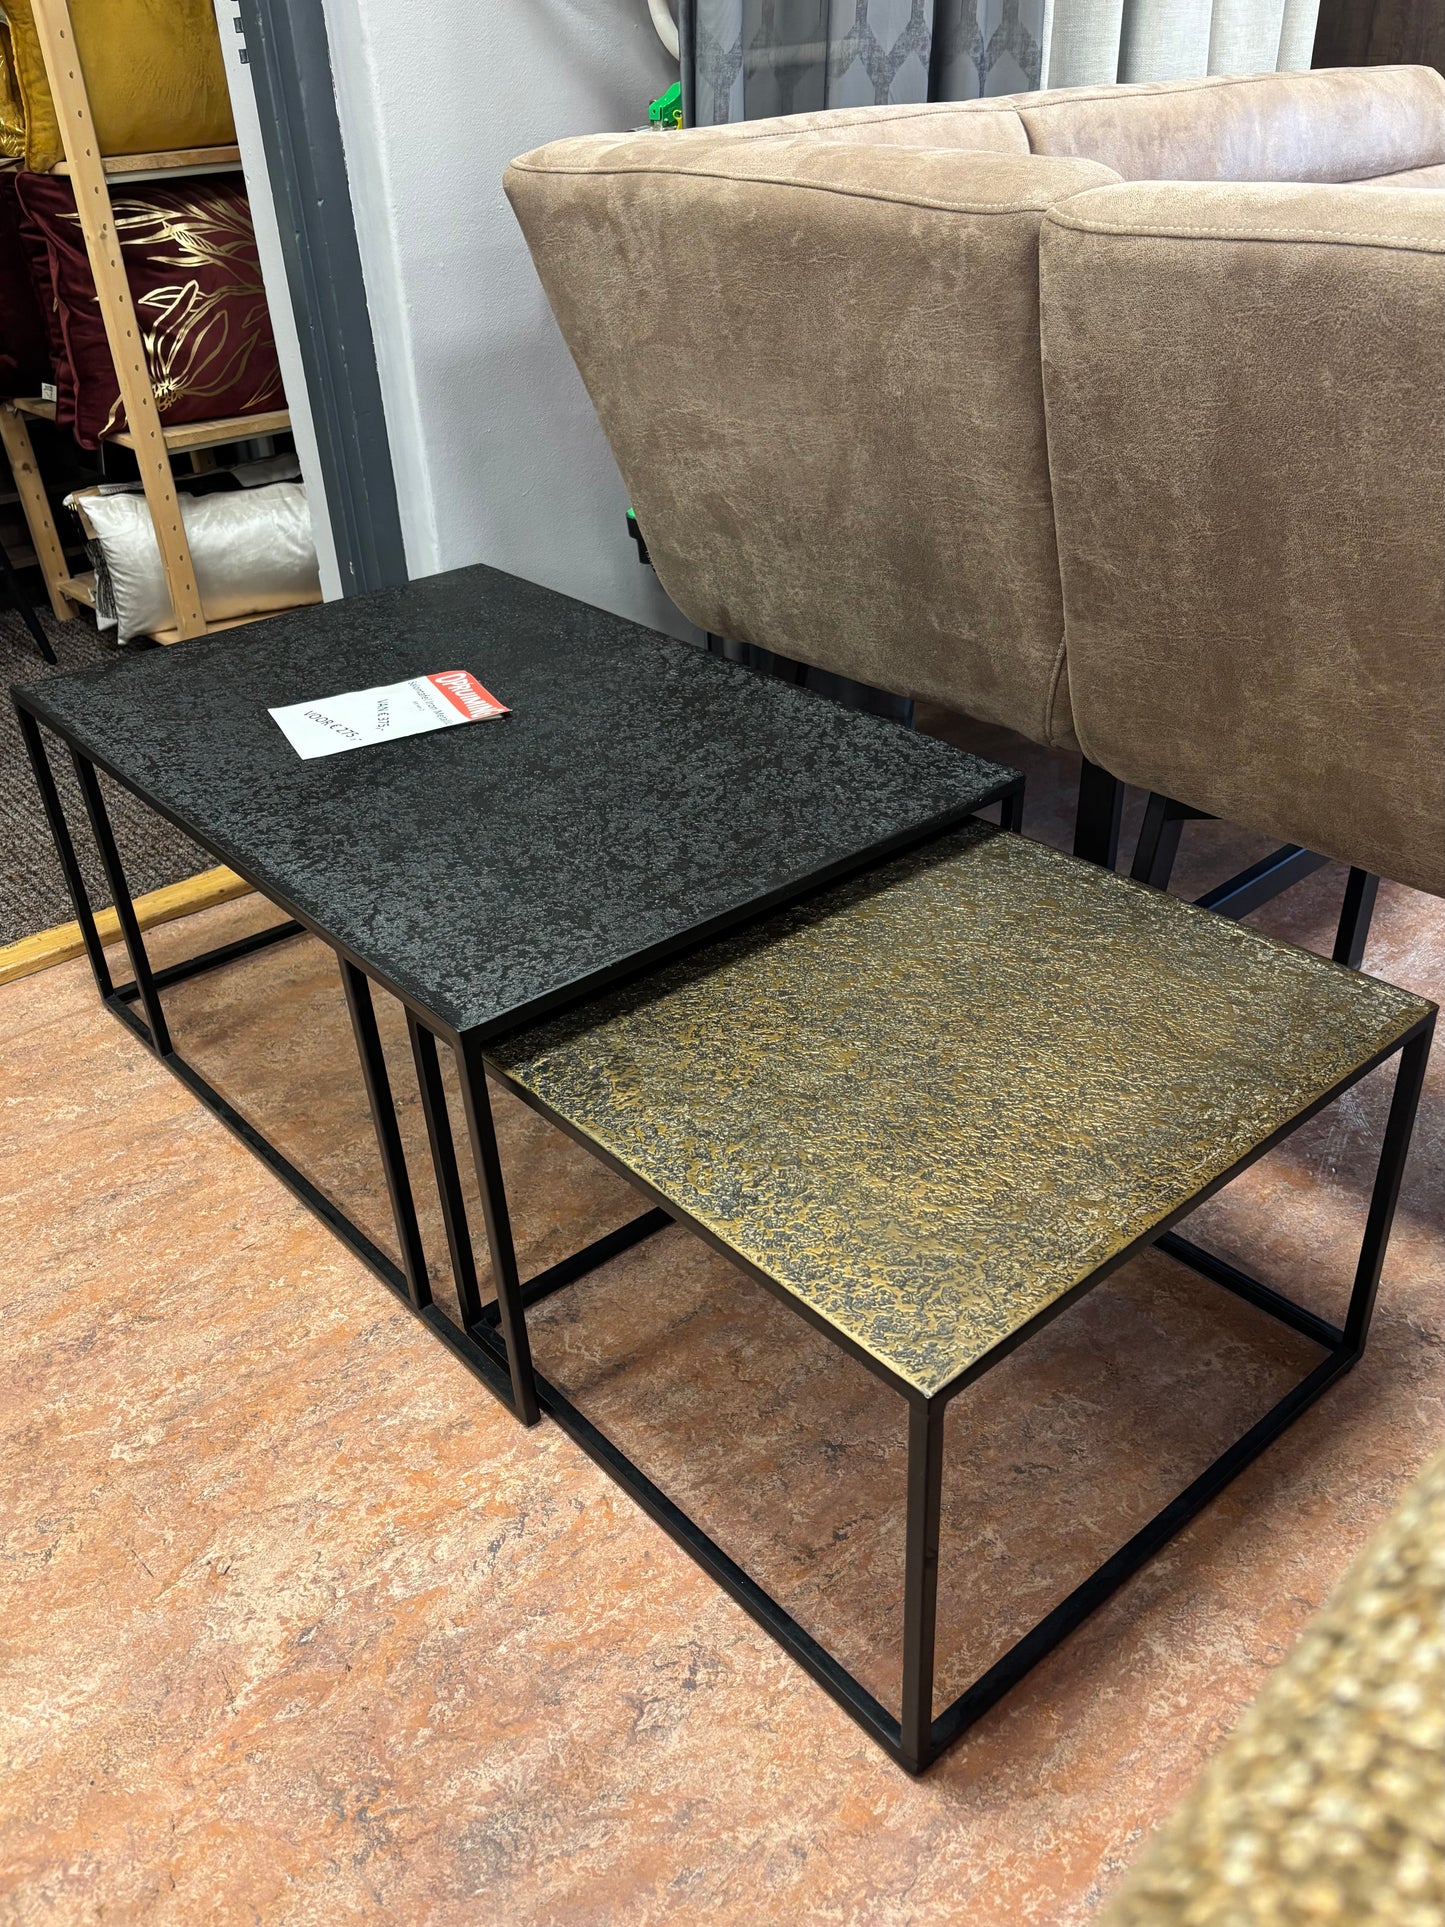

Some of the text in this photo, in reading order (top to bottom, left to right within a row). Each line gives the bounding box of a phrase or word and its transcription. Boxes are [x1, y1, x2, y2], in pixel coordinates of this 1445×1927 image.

[436, 673, 504, 718] OPRUIMING
[377, 699, 389, 711] VAN
[304, 710, 334, 726] VOOR
